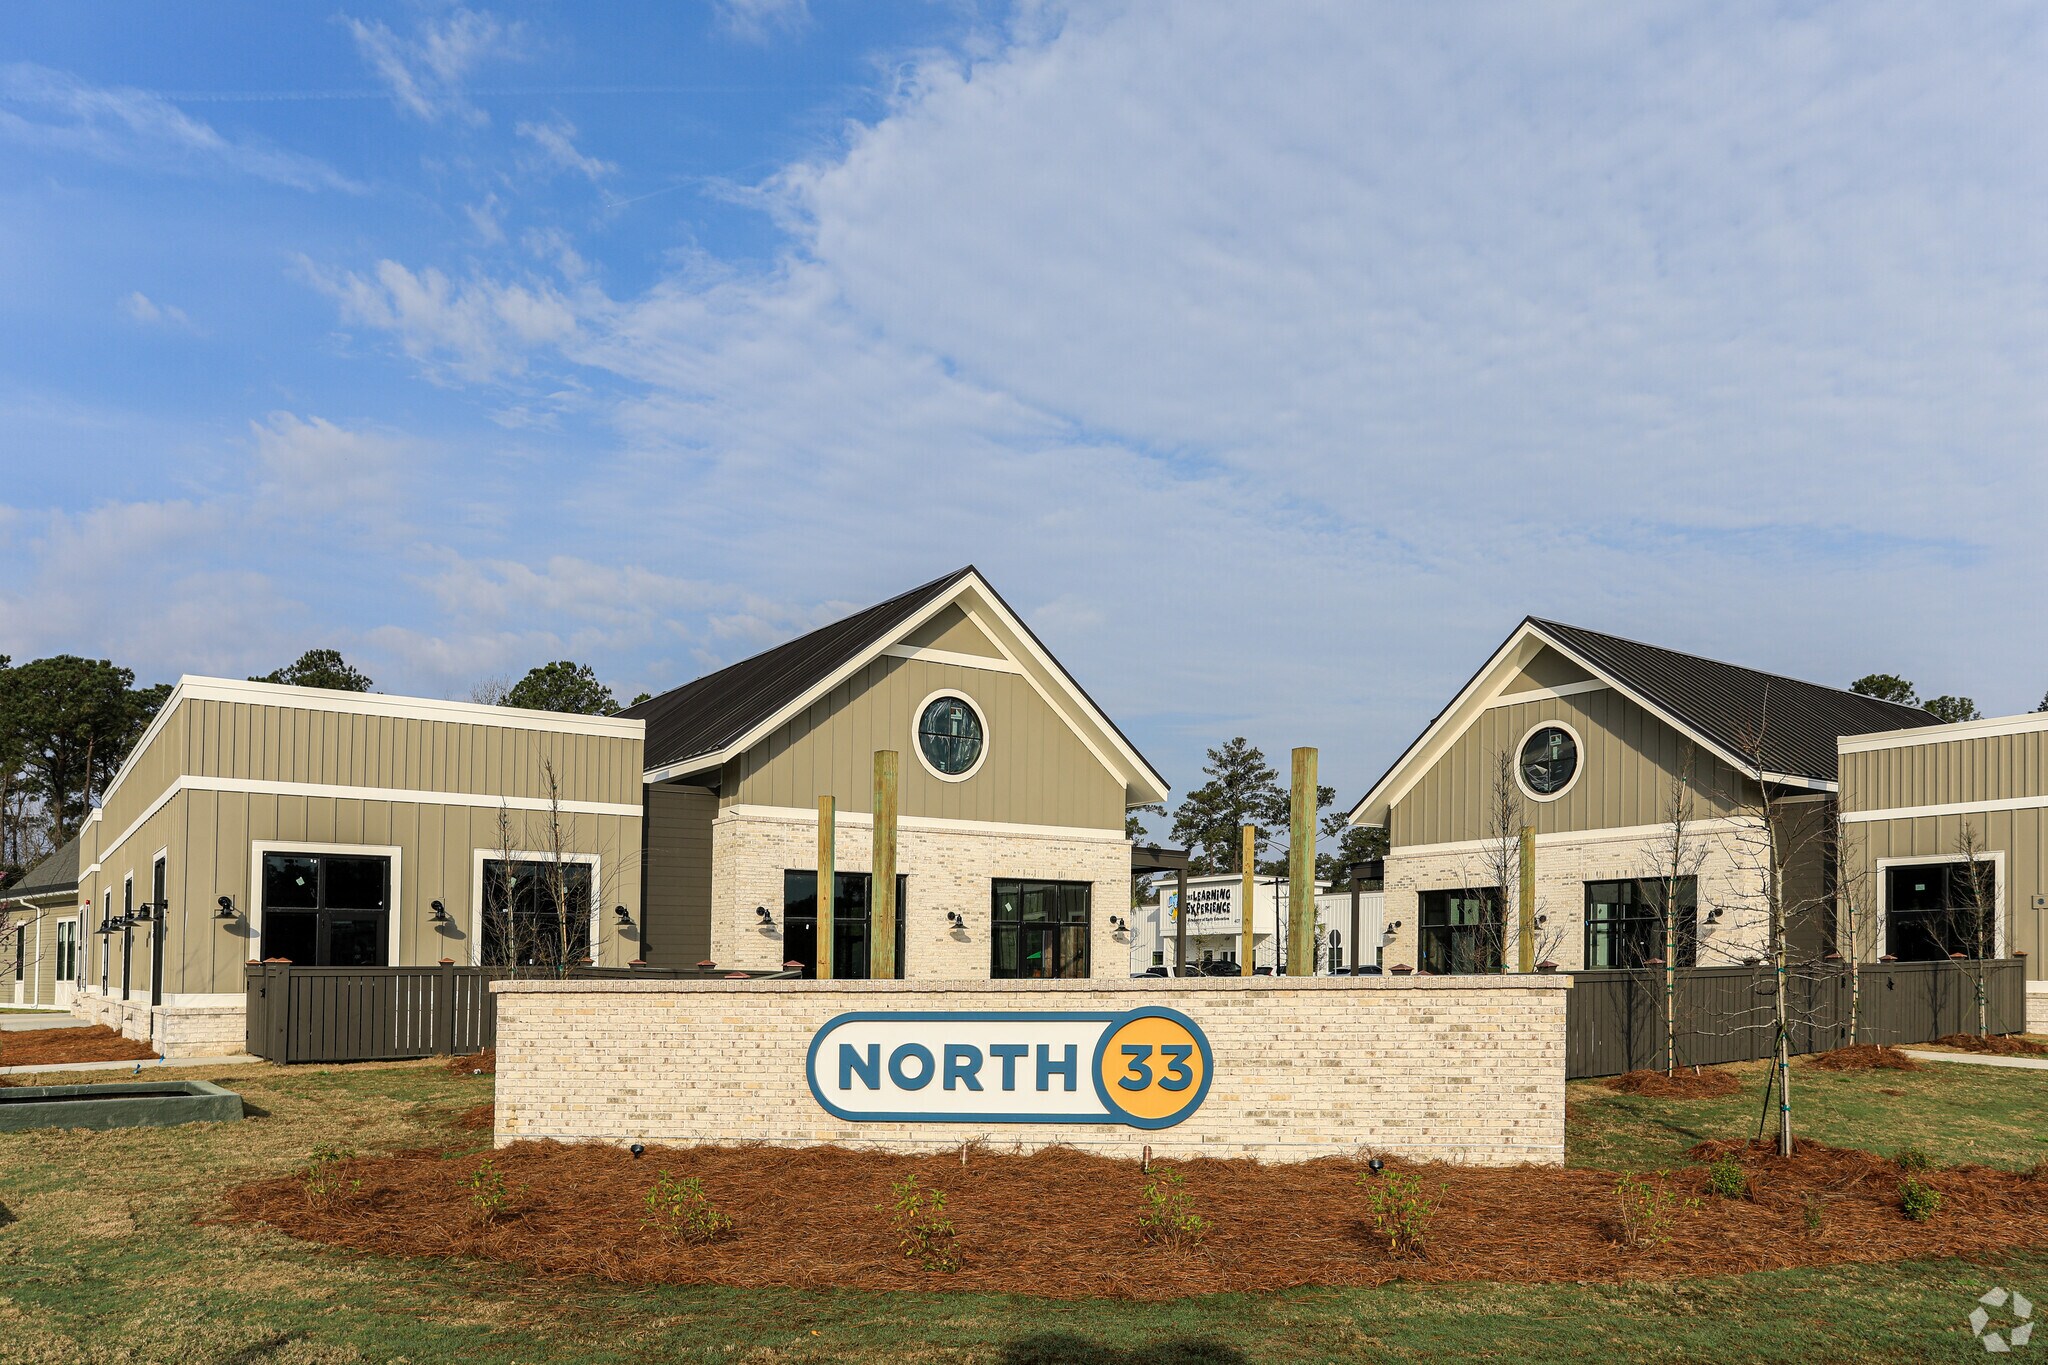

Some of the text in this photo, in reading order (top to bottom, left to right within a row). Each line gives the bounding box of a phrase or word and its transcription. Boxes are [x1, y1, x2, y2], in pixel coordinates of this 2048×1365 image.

[1193, 888, 1230, 901] LEARNING
[1186, 902, 1230, 917] EXPERIENCE
[838, 1043, 1193, 1091] NORTH 33
